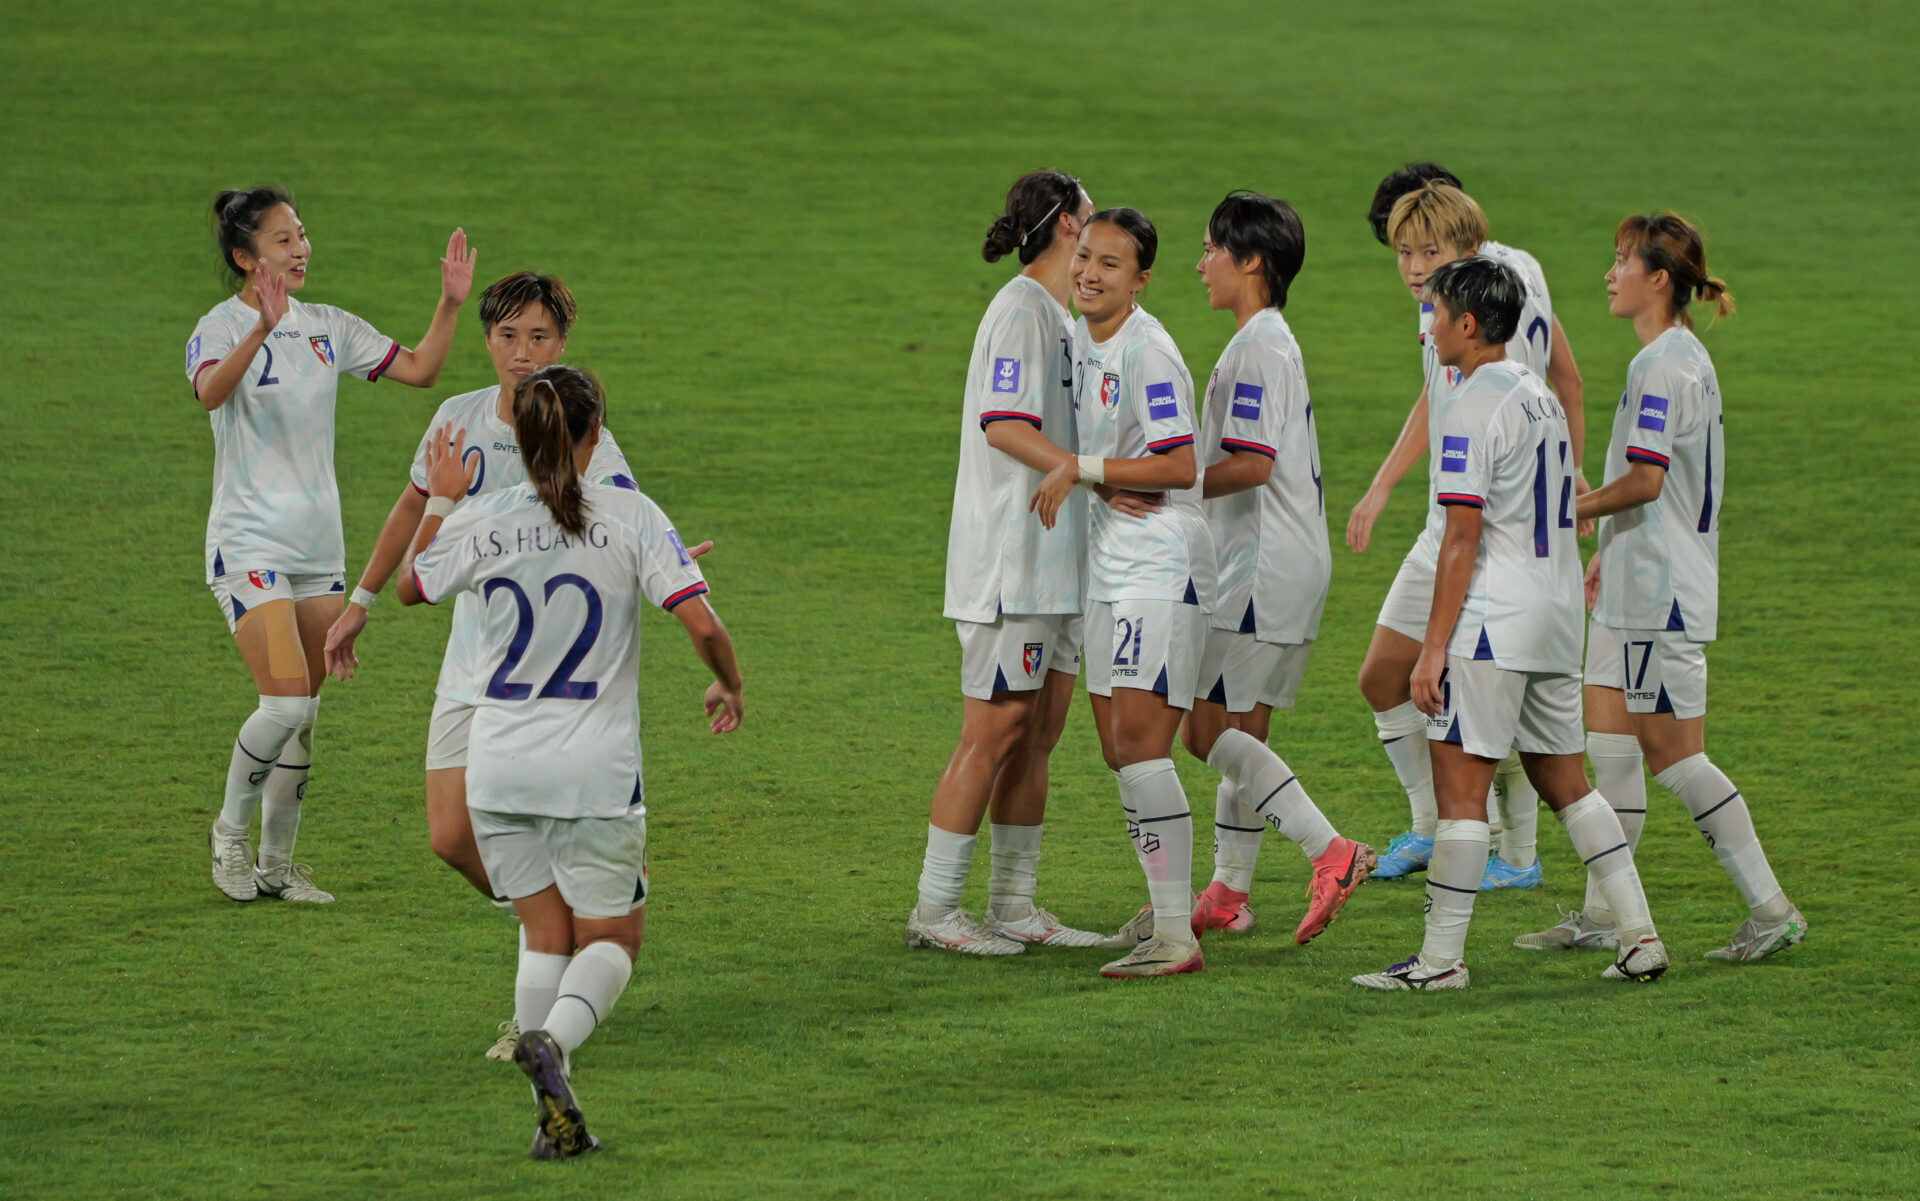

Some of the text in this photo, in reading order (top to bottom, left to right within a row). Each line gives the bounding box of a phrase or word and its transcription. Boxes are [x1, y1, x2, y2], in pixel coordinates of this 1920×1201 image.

[257, 343, 280, 387] 2
[494, 442, 521, 454] ENTE
[517, 522, 608, 553] HUANG
[484, 573, 603, 700] 22
[1113, 617, 1143, 666] 21
[1624, 640, 1654, 690] 17
[1626, 692, 1656, 700] ENTES
